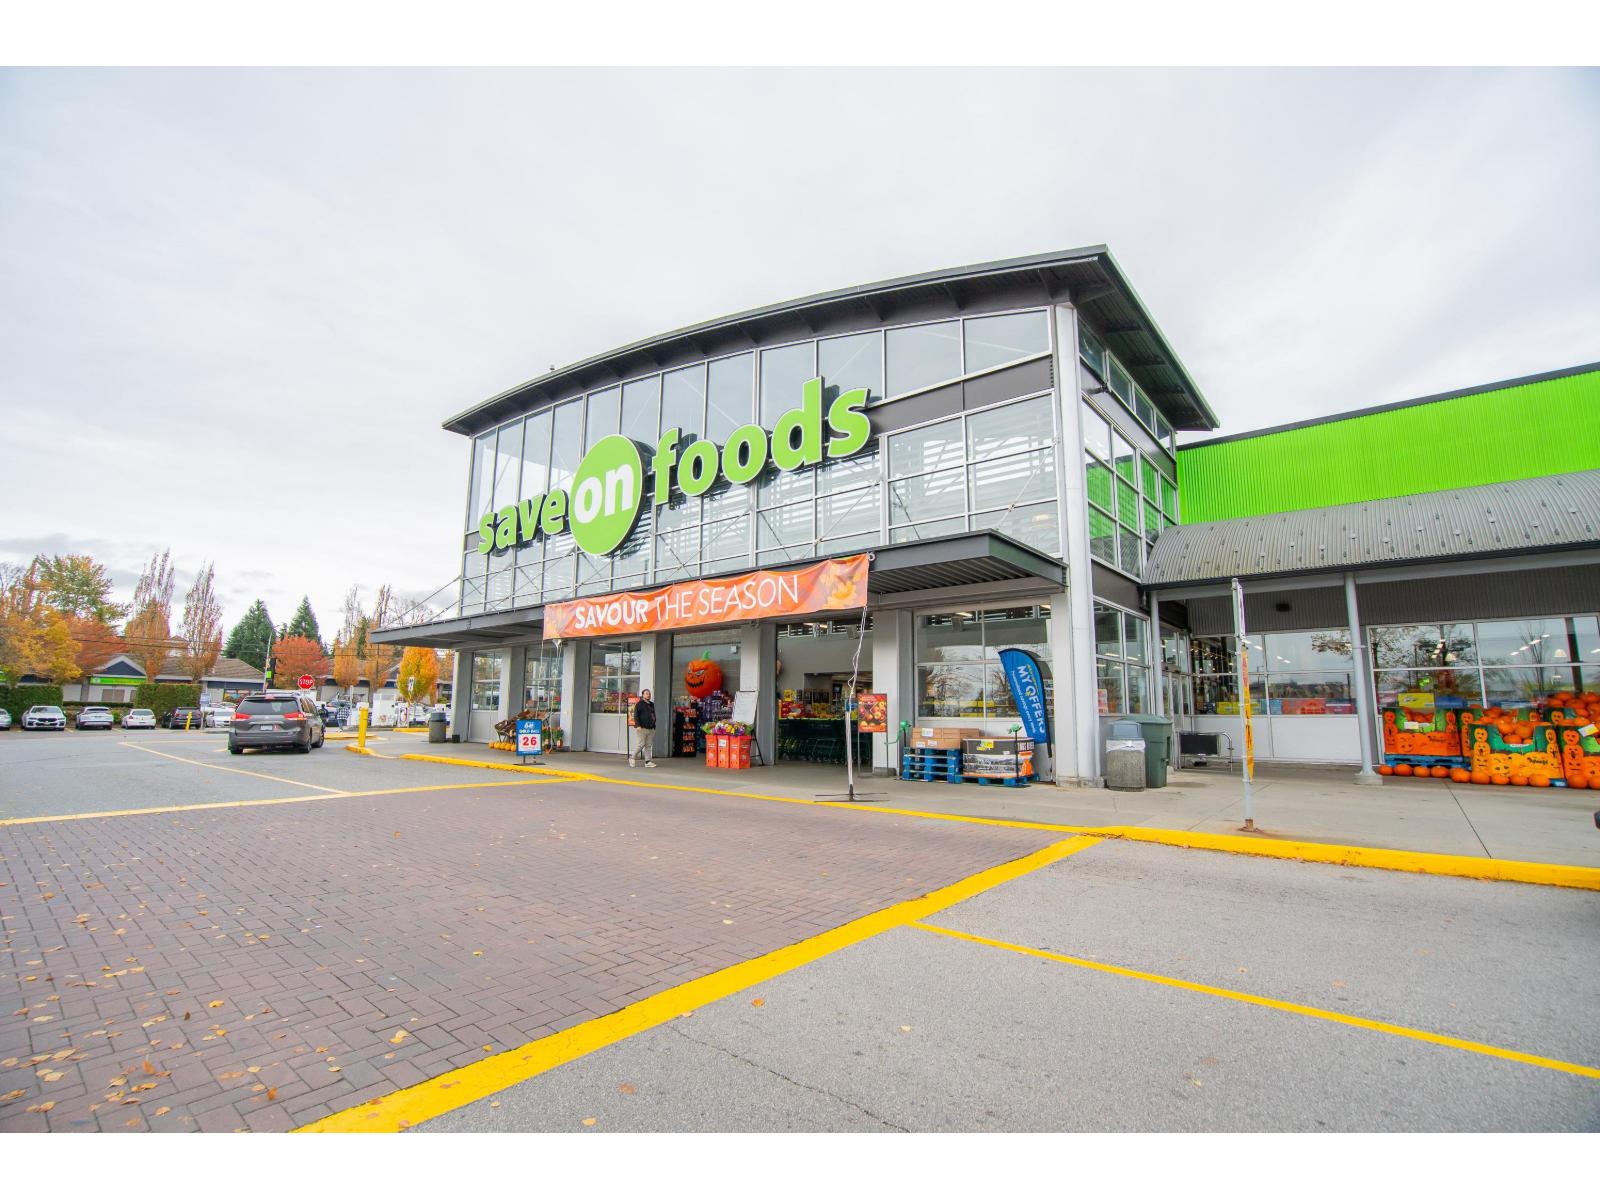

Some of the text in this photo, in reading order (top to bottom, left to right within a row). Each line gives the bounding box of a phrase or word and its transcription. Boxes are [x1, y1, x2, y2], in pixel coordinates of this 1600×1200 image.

[478, 376, 871, 554] save on foods
[574, 575, 799, 629] SAVOUR THE SEASON
[1017, 665, 1032, 683] MY
[522, 736, 537, 746] 26
